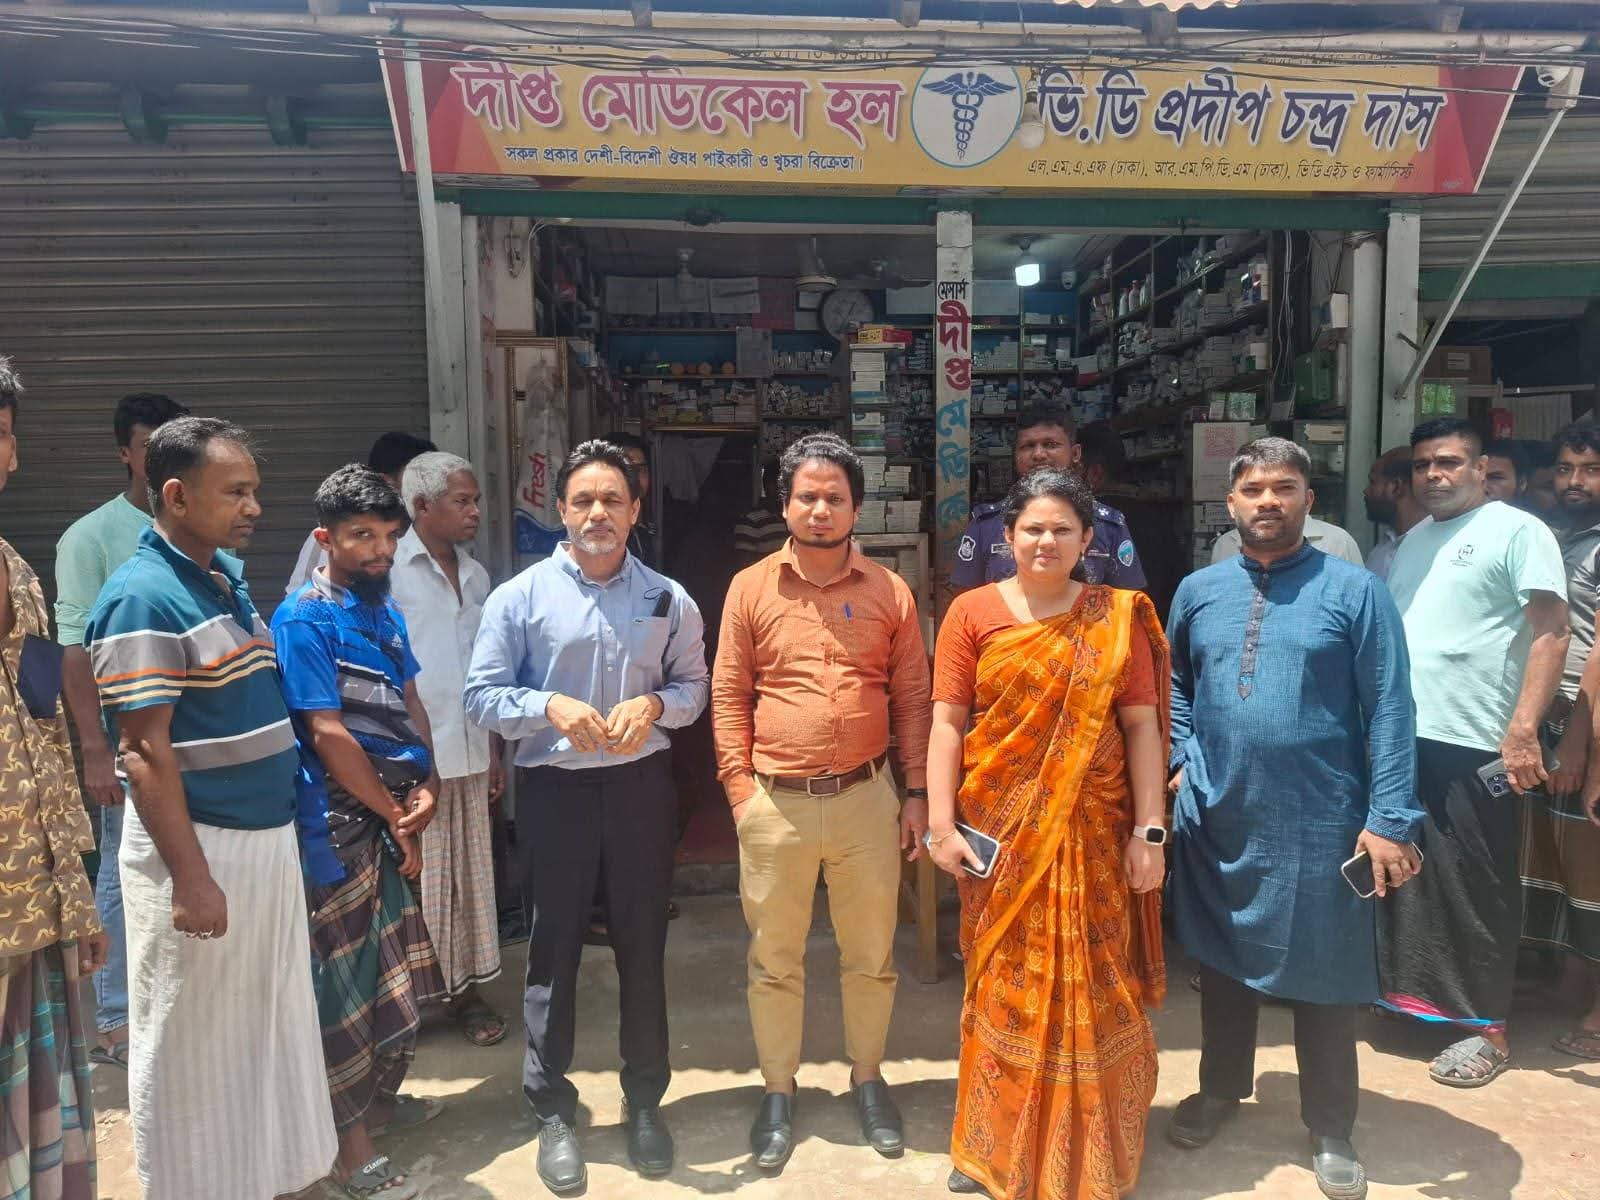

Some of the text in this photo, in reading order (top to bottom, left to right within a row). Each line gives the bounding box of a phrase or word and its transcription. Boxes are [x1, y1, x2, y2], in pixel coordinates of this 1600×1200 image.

[821, 80, 904, 149] হল
[1154, 67, 1272, 147] প্রদীপ
[1280, 90, 1356, 155] চন্দ্র
[1364, 86, 1447, 151] দাস
[505, 147, 537, 162] সকল
[544, 147, 578, 163] প্রকার
[584, 145, 661, 165] দেশী-বিদেশী
[668, 147, 697, 167] ঔষধ
[703, 148, 752, 168] পাইকারী
[758, 155, 768, 167] ও
[774, 155, 803, 172] খুচরা
[1352, 165, 1361, 178] ও
